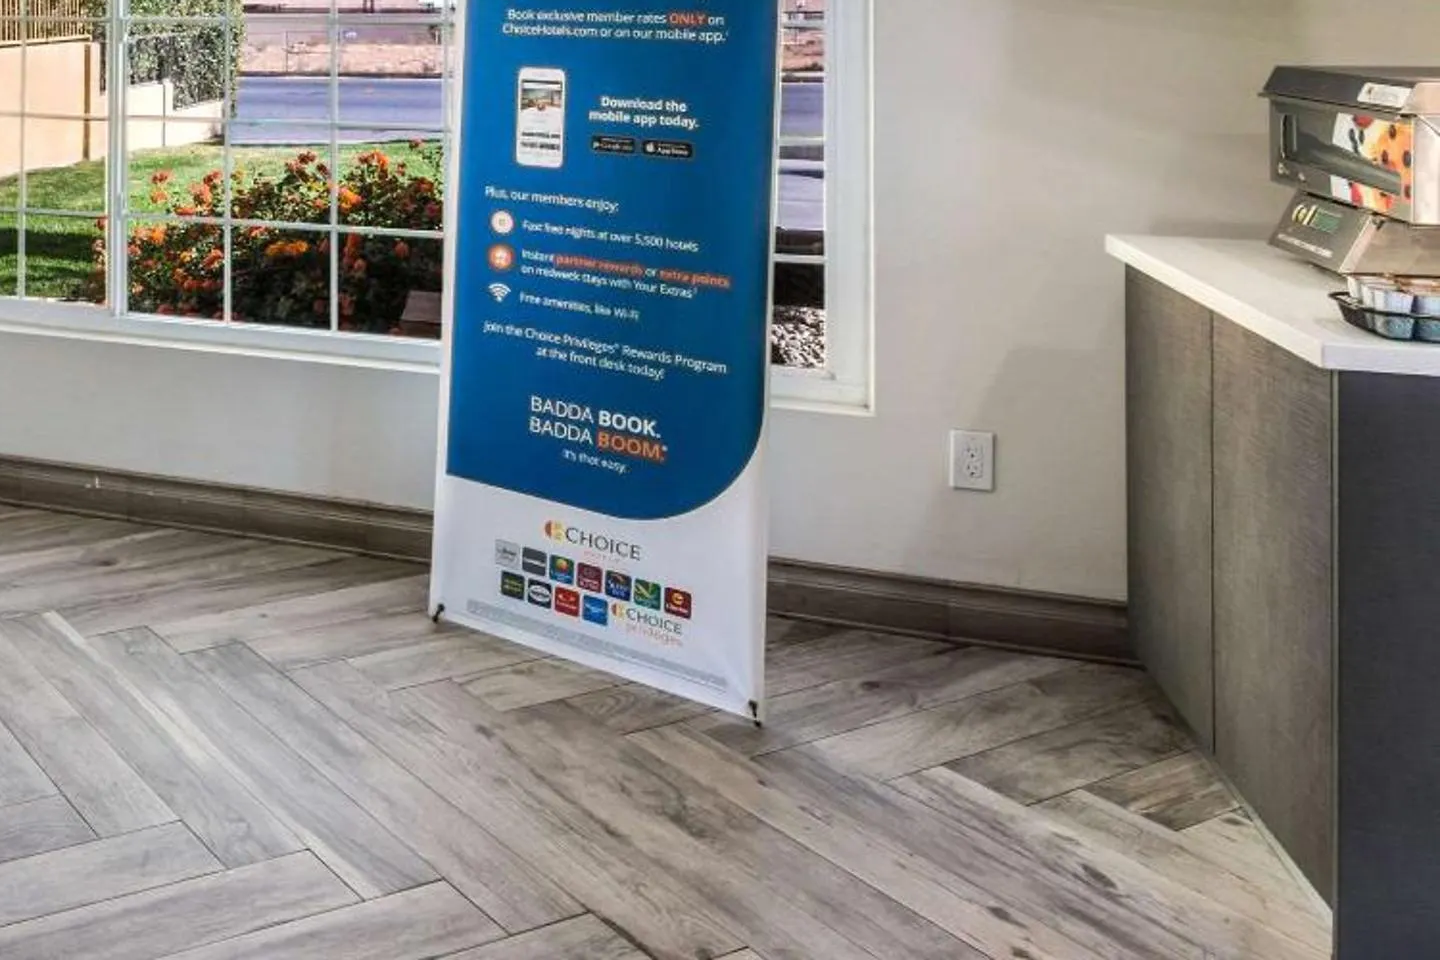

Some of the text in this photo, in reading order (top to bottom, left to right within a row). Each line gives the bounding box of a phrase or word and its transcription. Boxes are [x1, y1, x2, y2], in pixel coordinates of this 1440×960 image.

[508, 9, 724, 25] Book exclusive member rates ONLY on
[502, 23, 598, 37] ChoiceHotels.com
[601, 28, 612, 38] or
[615, 28, 631, 38] on
[633, 29, 653, 39] our
[656, 28, 696, 41] mobile
[600, 96, 687, 111] Download the
[588, 110, 699, 130] mobile app today.
[510, 192, 529, 202] our
[531, 192, 584, 208] members
[565, 225, 595, 240] nights
[597, 230, 609, 240] at
[610, 233, 633, 243] over
[634, 233, 663, 249] 5,500
[665, 237, 700, 252] hotels
[520, 266, 535, 275] on
[610, 276, 632, 289] with
[633, 280, 658, 293] Your
[521, 248, 555, 263] Instant
[645, 267, 657, 276] or
[690, 273, 731, 288] points
[613, 307, 640, 322] Wi-Fi
[483, 320, 503, 334] Join
[505, 324, 523, 337] the
[525, 327, 560, 344] Choice
[622, 345, 672, 365] Rewards
[675, 354, 727, 375] Program
[536, 346, 547, 357] at
[548, 348, 567, 362] the
[569, 352, 597, 368] front
[599, 356, 626, 372] desk
[530, 395, 661, 439] BADDA BOOK.
[529, 417, 593, 445] BADDA
[579, 451, 599, 467] that
[565, 527, 641, 561] CHOICE
[626, 607, 682, 635] CHOICE
